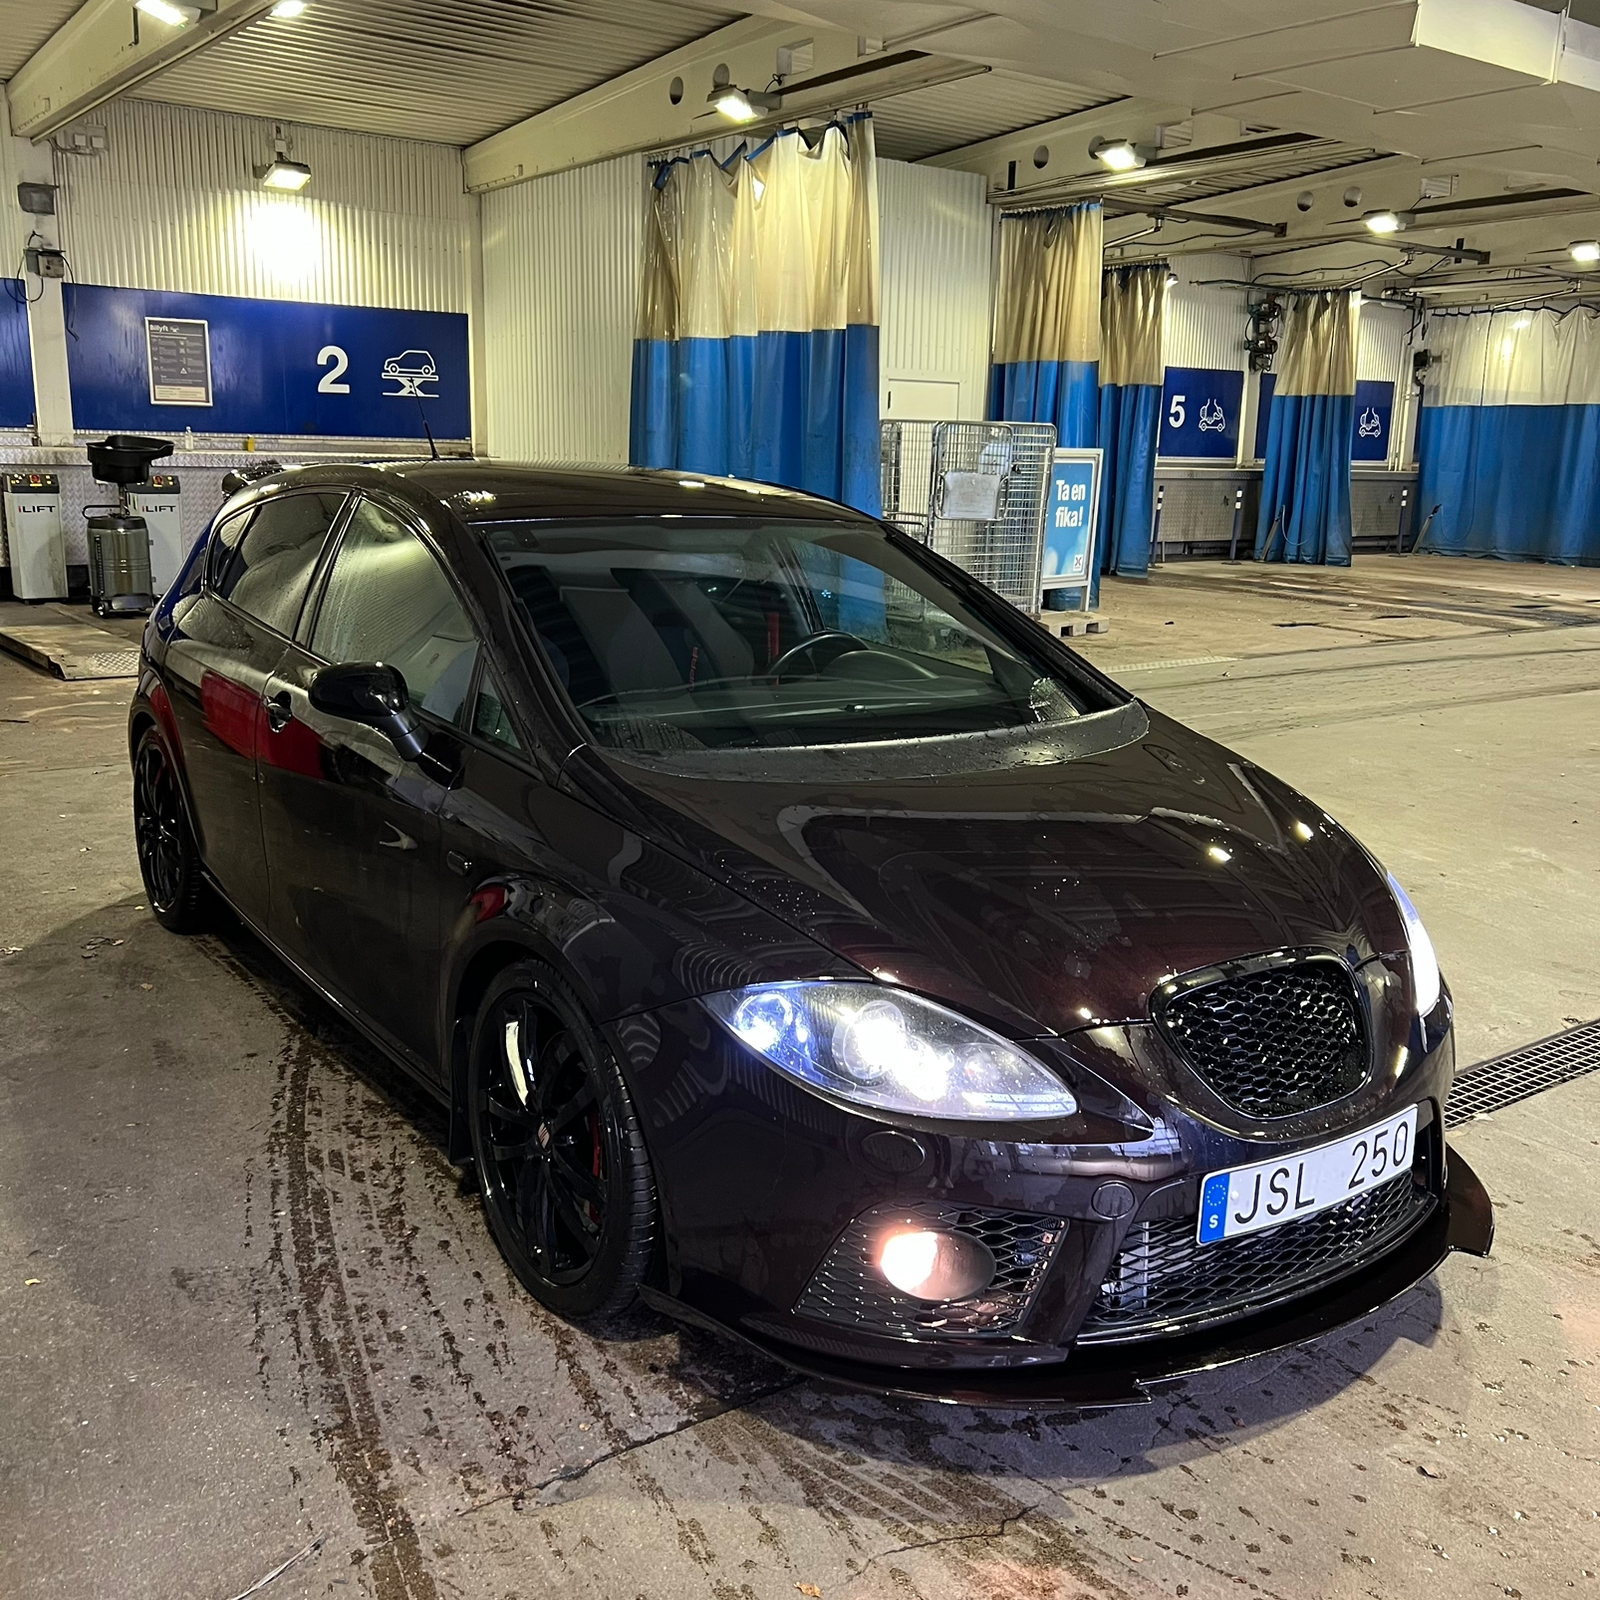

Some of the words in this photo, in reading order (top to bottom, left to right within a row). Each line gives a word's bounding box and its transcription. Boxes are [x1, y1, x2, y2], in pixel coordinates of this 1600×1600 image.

[317, 345, 350, 394] 2
[1168, 395, 1186, 428] 5
[1055, 480, 1069, 501] Ta
[1071, 483, 1086, 501] en
[1055, 506, 1084, 528] fika!
[1234, 1163, 1315, 1224] JSL
[1348, 1121, 1409, 1190] 250
[1209, 1214, 1219, 1229] S
